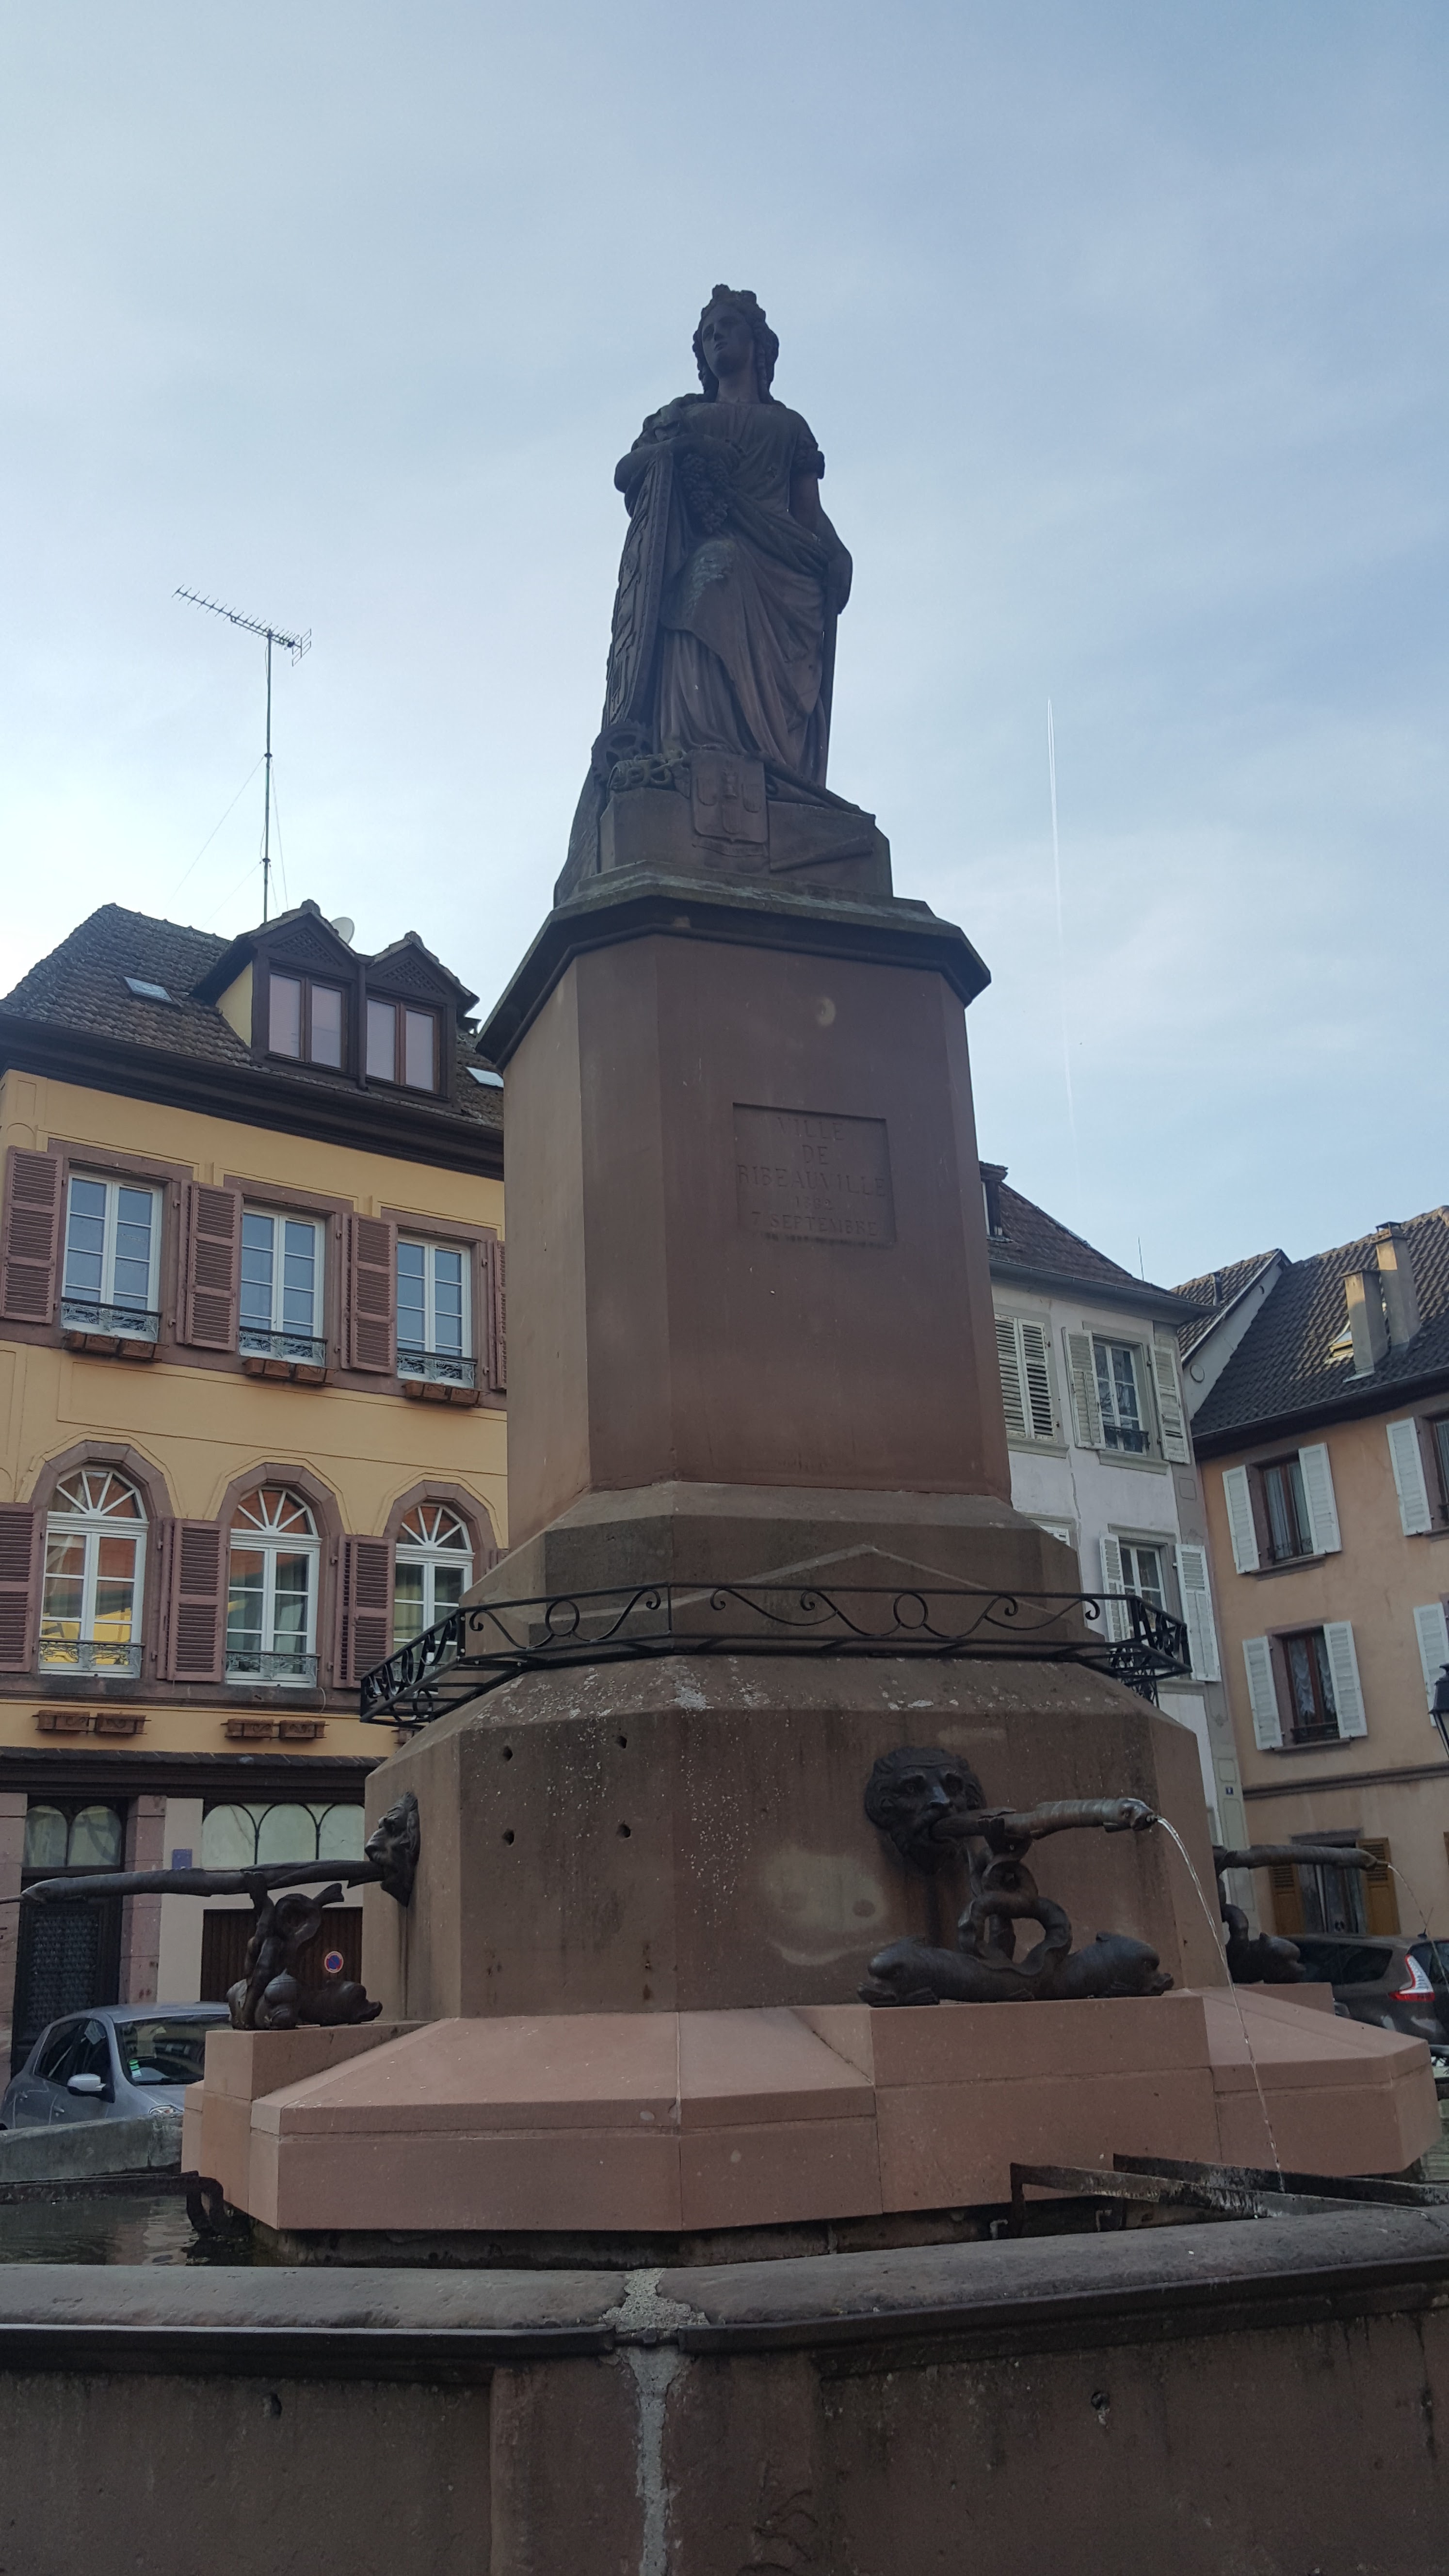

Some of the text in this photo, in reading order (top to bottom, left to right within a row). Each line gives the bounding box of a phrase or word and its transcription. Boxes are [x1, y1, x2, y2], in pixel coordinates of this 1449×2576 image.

[777, 1116, 845, 1141] VILLE
[802, 1144, 829, 1165] DE
[737, 1164, 886, 1197] RIBEAUVILLE
[770, 1213, 879, 1237] SEPTEMBRE
